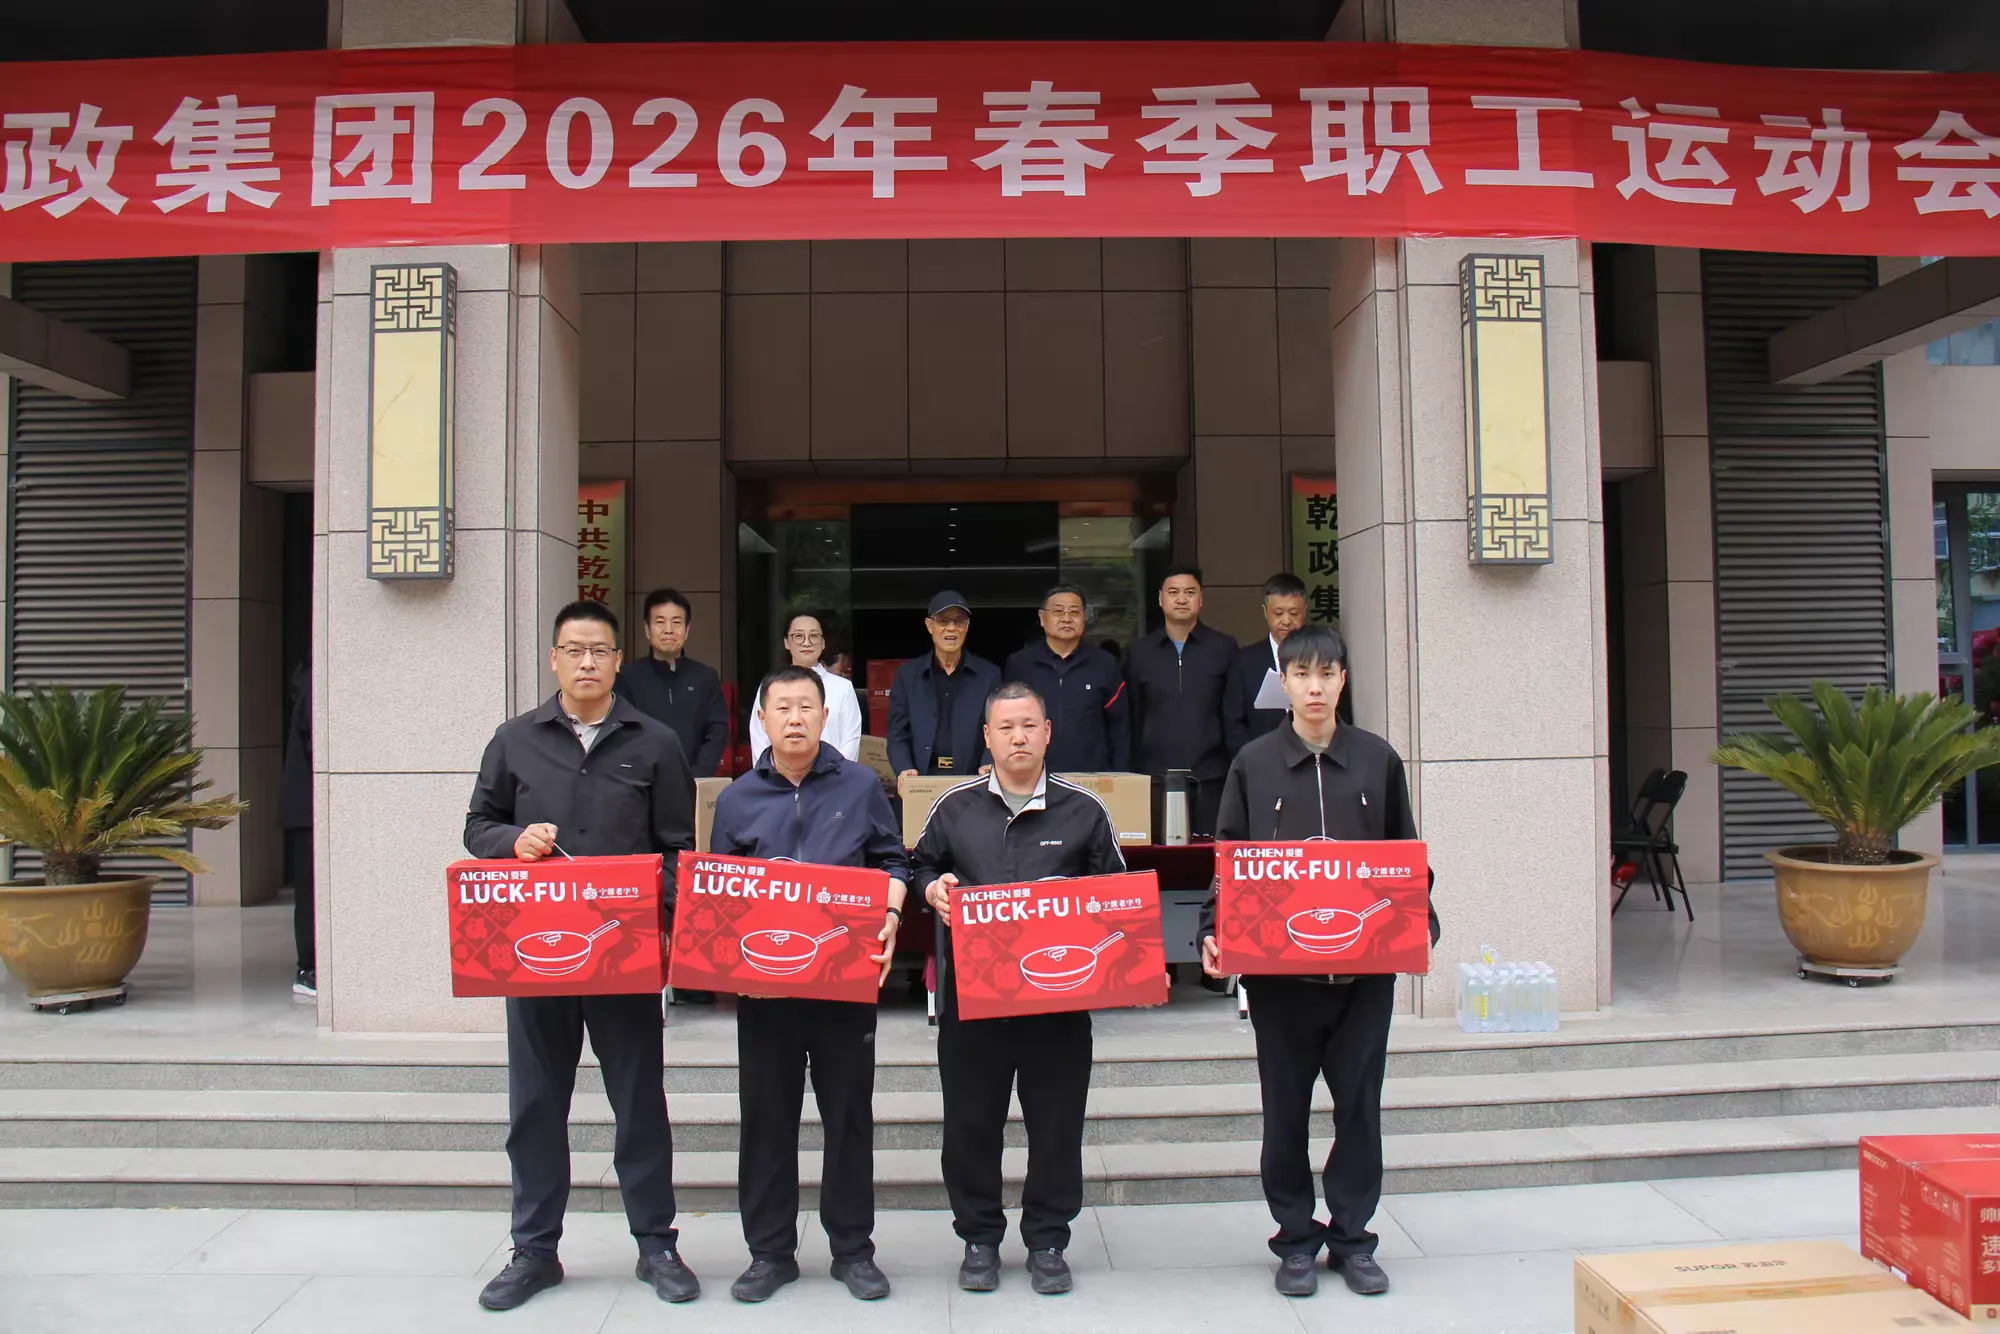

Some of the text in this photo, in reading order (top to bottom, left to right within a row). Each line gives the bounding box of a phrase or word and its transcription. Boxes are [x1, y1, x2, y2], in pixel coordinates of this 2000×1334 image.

[0, 80, 2000, 219] 政集团2026年春季职工运动会
[1233, 847, 1283, 858] AICHEN
[460, 870, 508, 881] AICHEN
[694, 861, 745, 875] AICHEN
[1233, 859, 1341, 881] LUCK-FU
[460, 882, 566, 904] LUCK-FU
[692, 873, 801, 903] LUCK-FU
[961, 889, 1011, 903] AICHEN
[961, 896, 1070, 925] LUCK-FU
